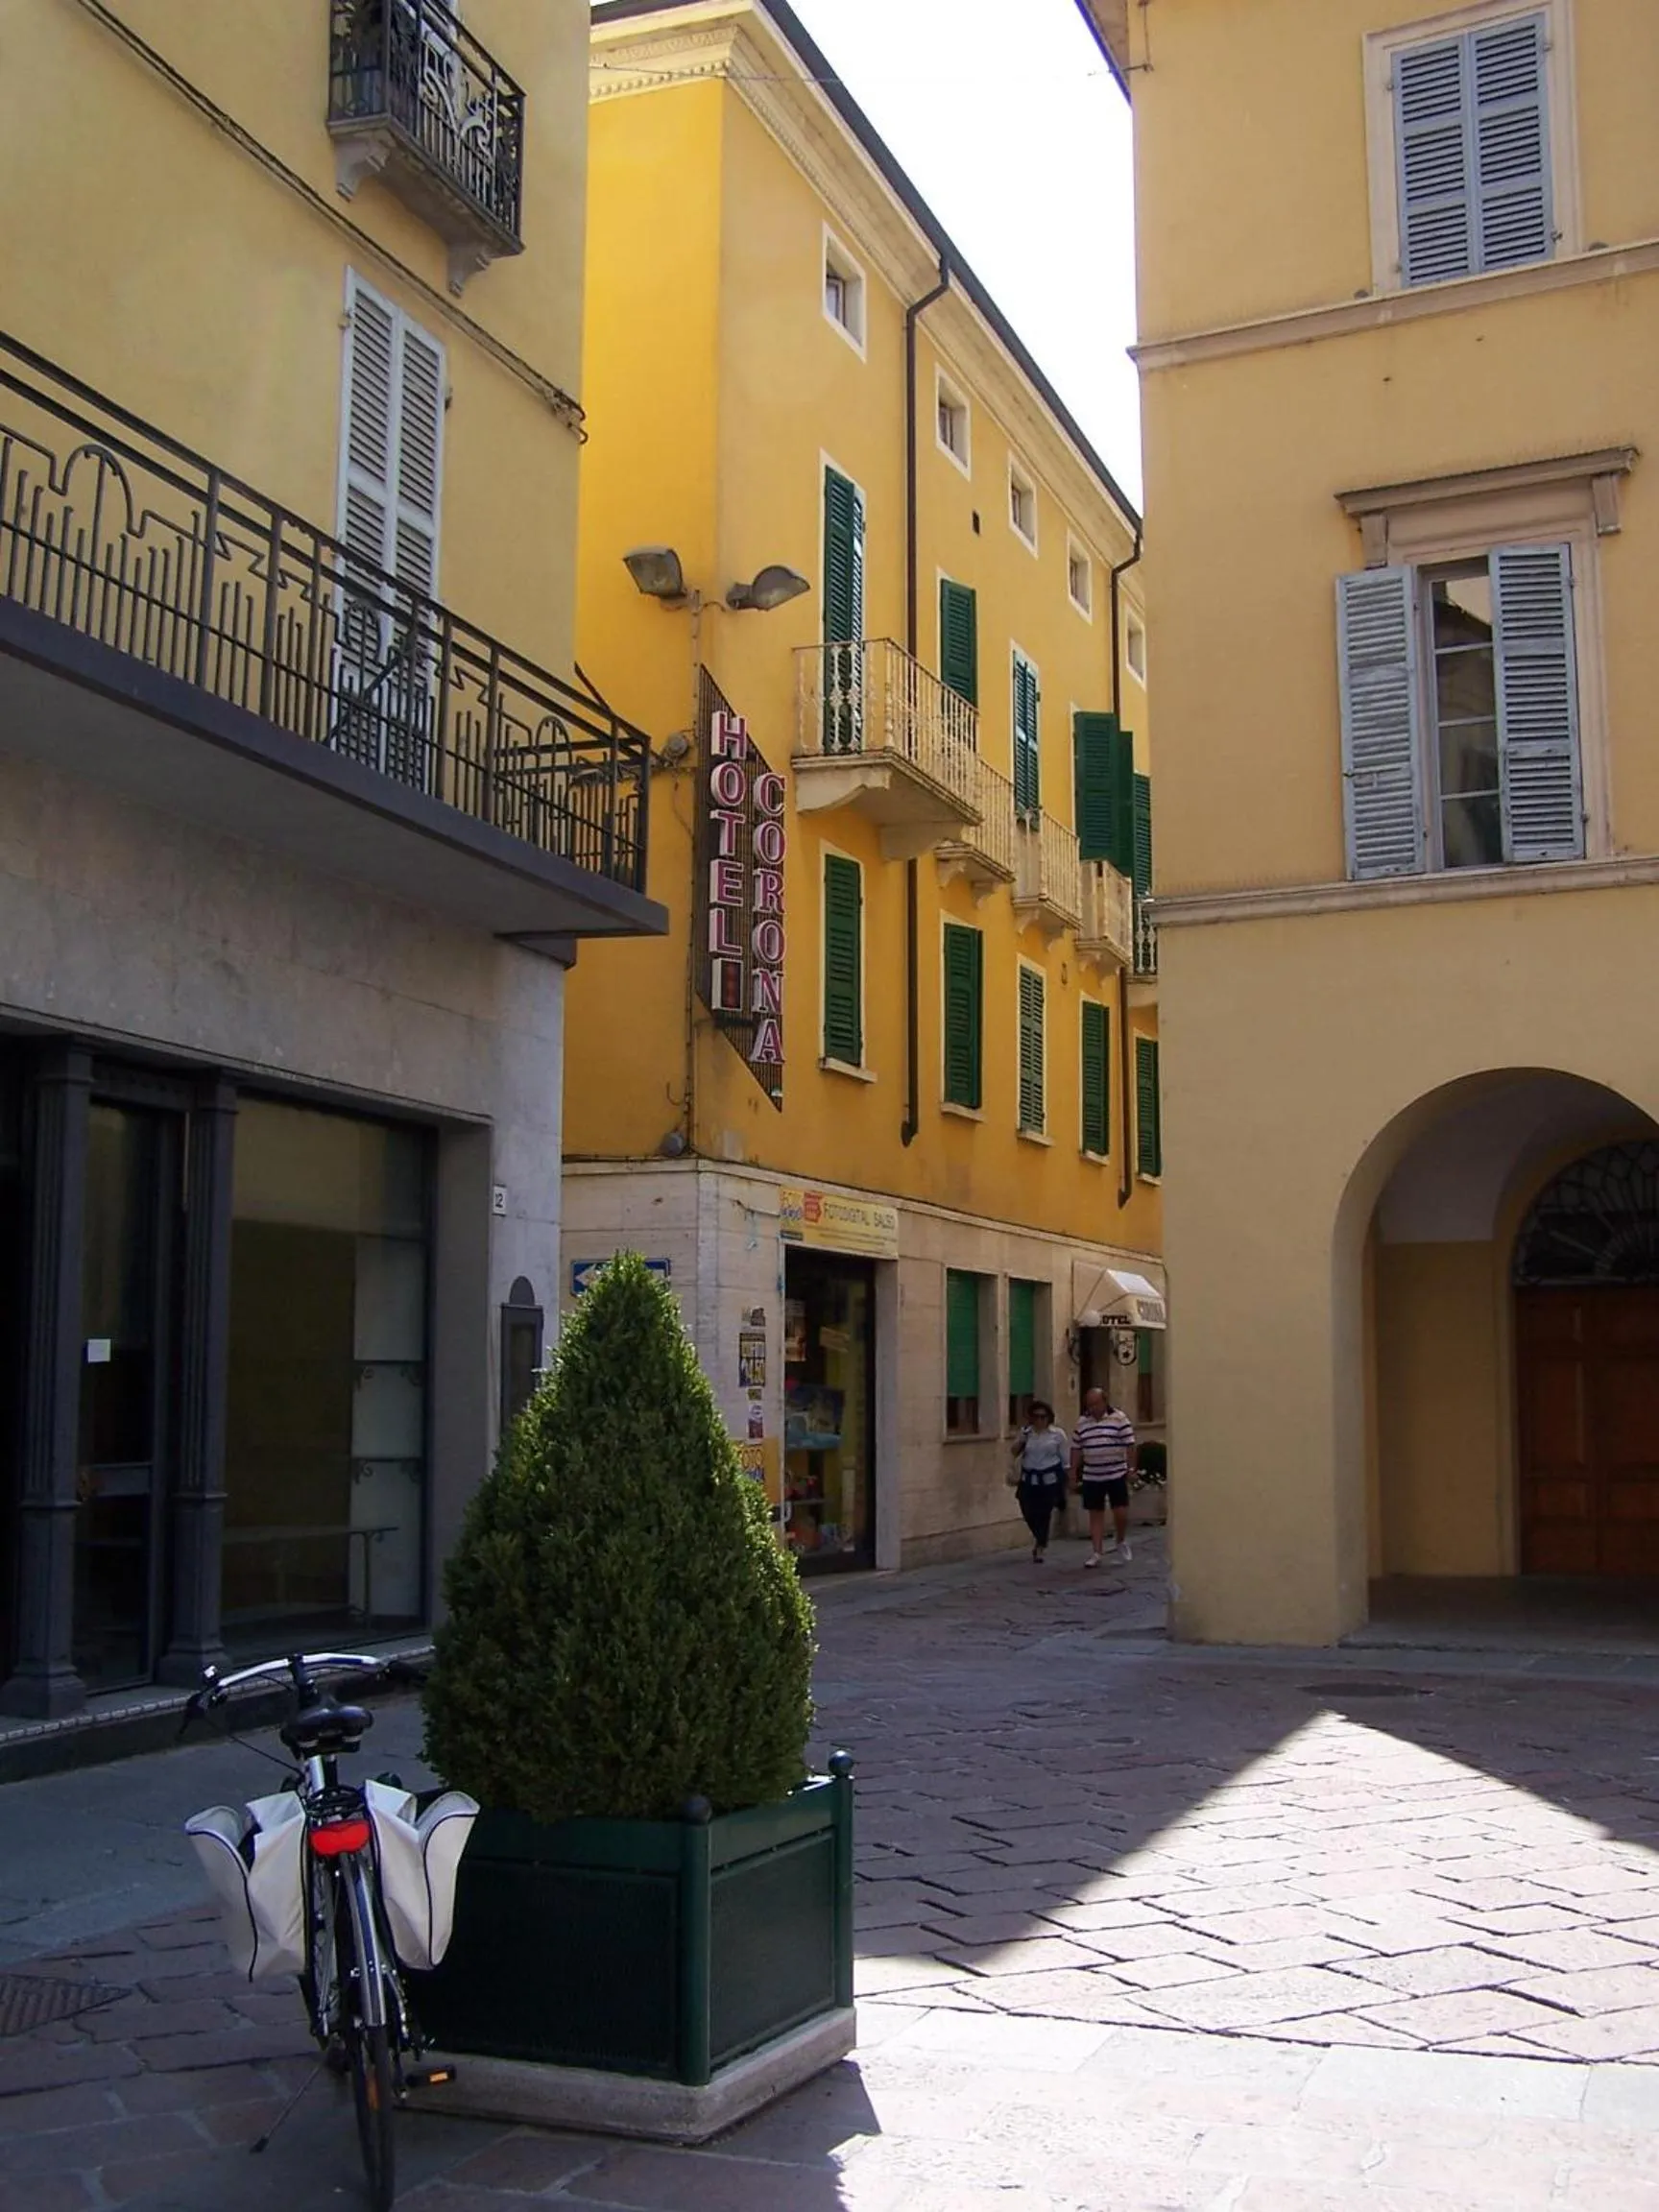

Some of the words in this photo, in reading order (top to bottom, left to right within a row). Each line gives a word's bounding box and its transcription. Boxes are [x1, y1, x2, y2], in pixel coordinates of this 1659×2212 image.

[709, 710, 747, 955] HOTEL
[750, 773, 786, 1063] CORONA
[1100, 1314, 1132, 1325] OTEL
